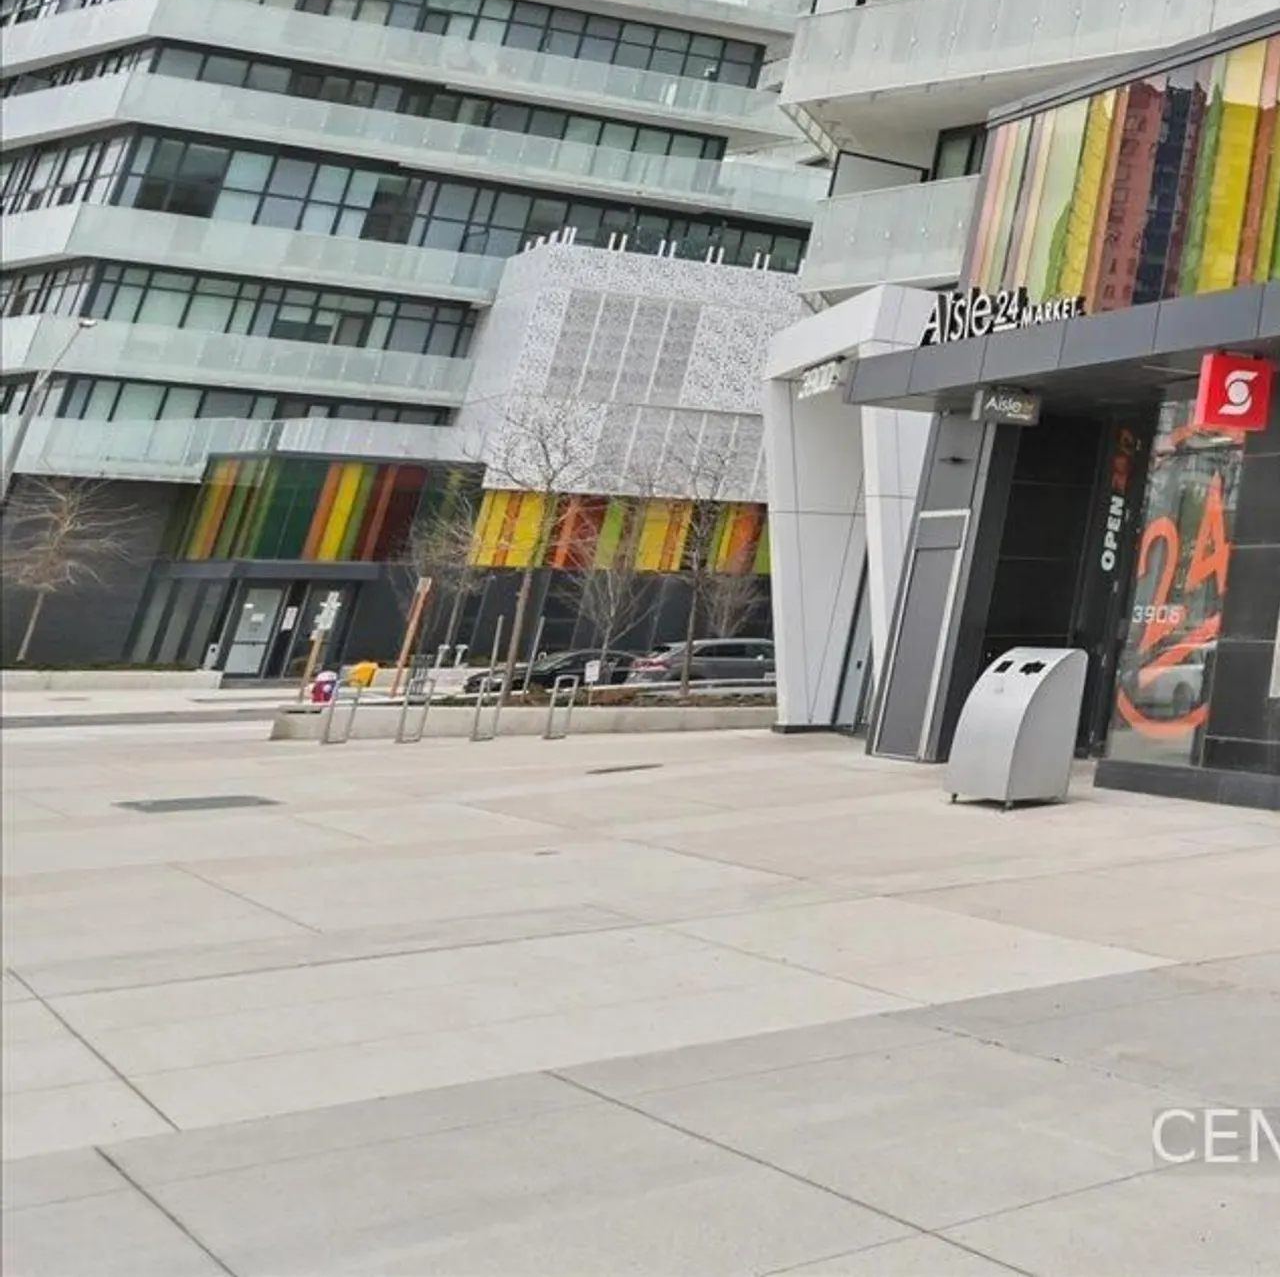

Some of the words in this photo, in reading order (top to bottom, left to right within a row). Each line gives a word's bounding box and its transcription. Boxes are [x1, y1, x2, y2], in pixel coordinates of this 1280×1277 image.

[918, 287, 992, 349] Aisle
[993, 290, 1019, 325] 24
[1020, 295, 1078, 329] MARKET
[1100, 494, 1125, 571] OPEN
